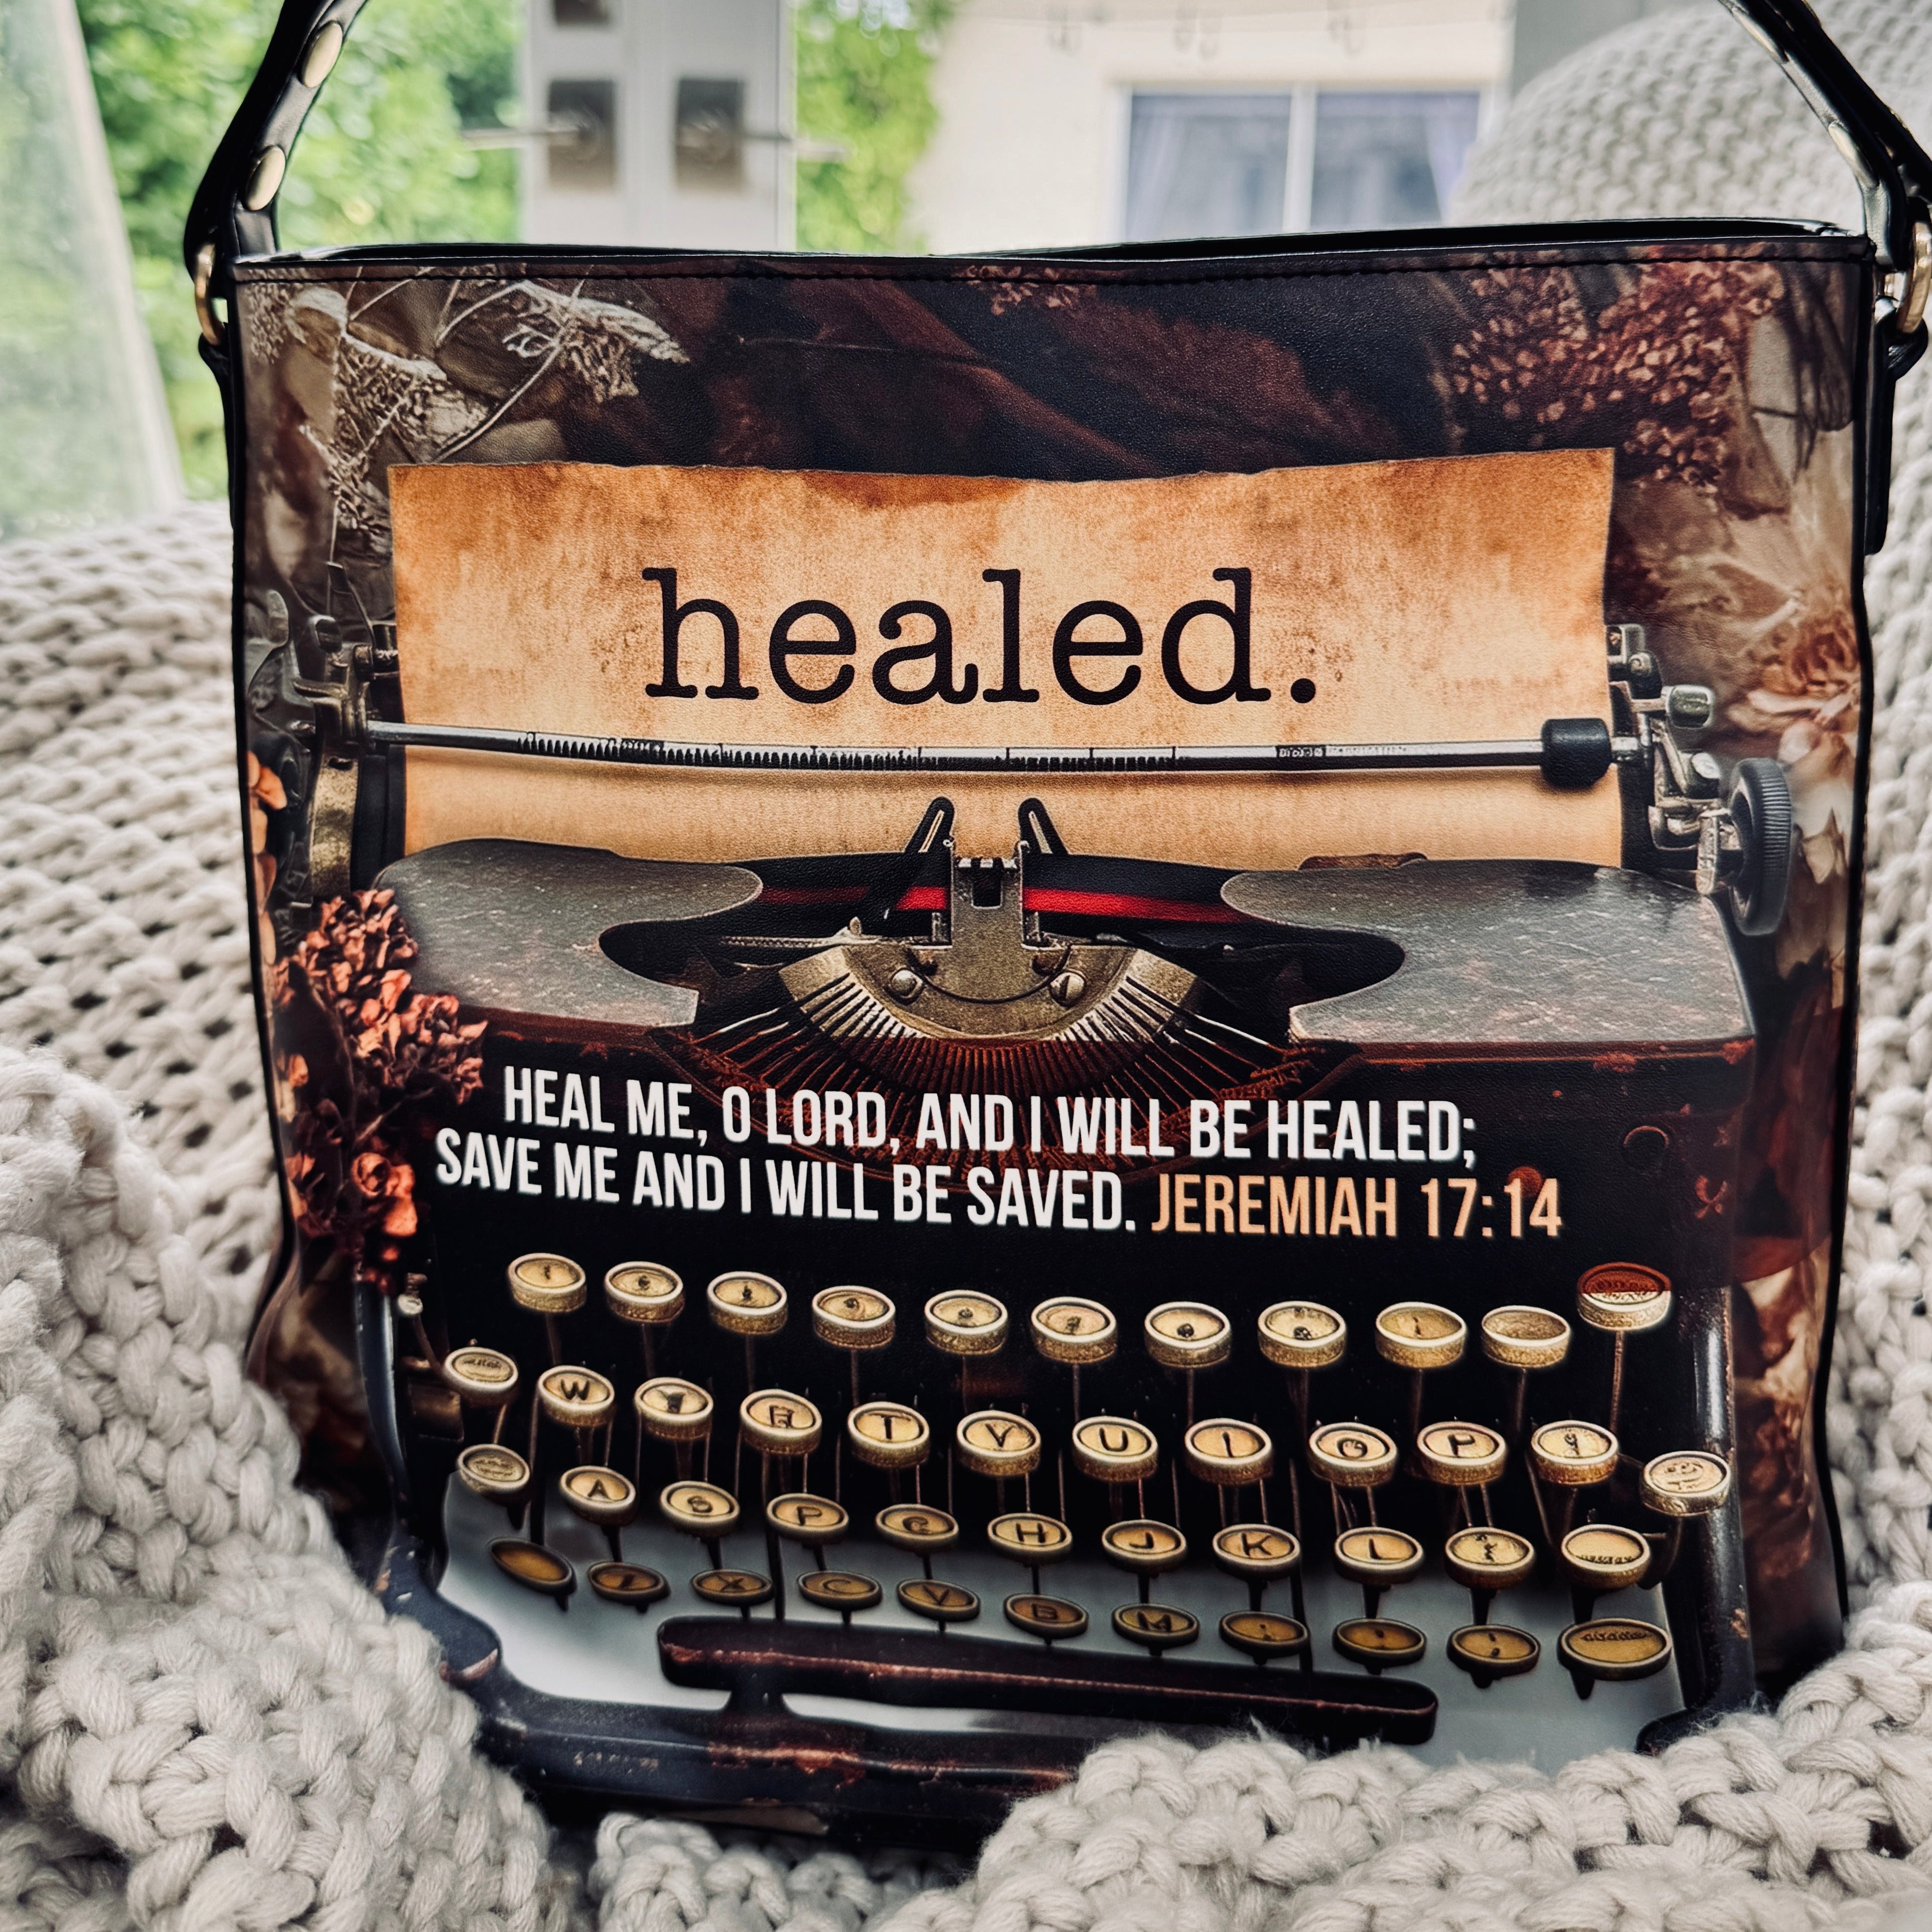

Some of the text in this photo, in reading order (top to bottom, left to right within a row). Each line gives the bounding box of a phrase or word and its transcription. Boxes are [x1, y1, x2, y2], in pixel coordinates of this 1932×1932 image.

[641, 566, 1317, 706] healed.
[504, 1065, 1475, 1168] HEAL ME, O LORD, AND I WILL BE HEALED;
[436, 1127, 1562, 1238] SAVE ME AND I WILL BE SAVED. JEREMIAH 17:14
[560, 1378, 589, 1401] W
[1099, 1427, 1128, 1452] U
[586, 1478, 610, 1500] A
[1015, 1522, 1047, 1543] H
[1129, 1531, 1154, 1550] J
[1241, 1532, 1272, 1557] K
